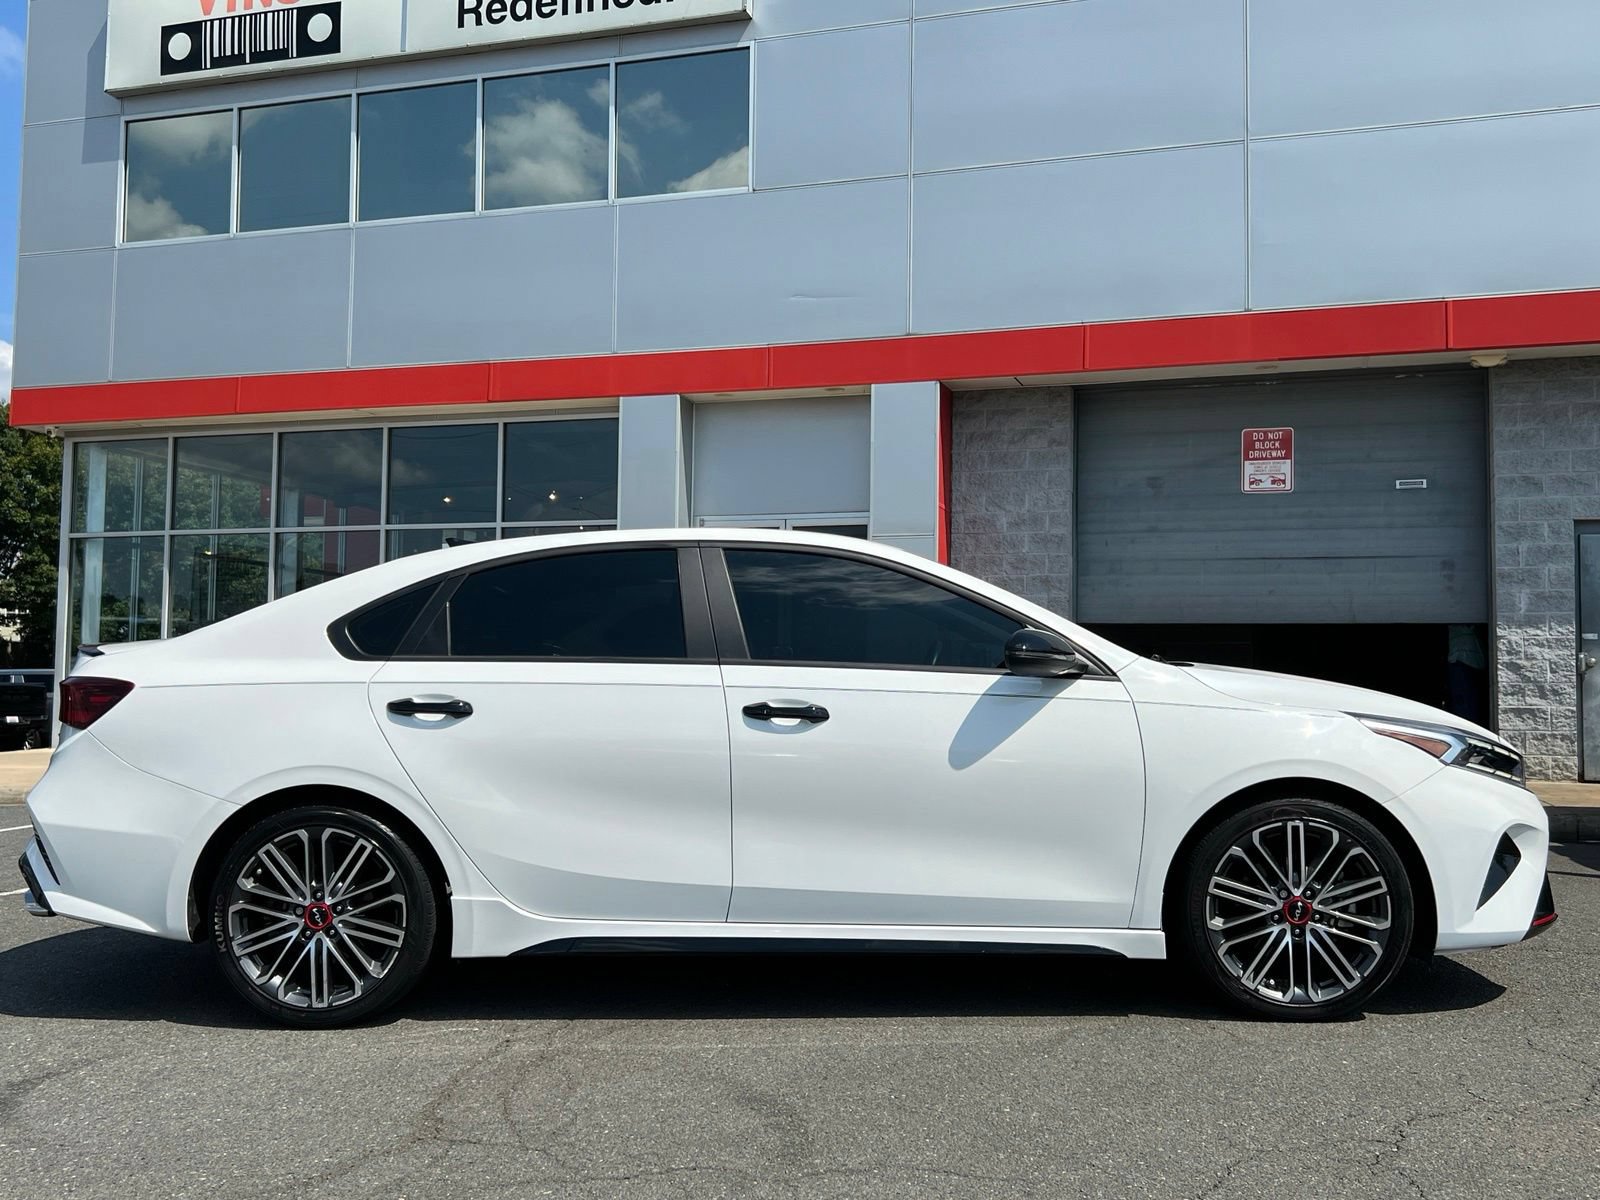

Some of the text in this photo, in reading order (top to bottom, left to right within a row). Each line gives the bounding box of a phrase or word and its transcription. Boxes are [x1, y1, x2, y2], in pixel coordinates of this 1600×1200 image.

[457, 0, 675, 28] Reden
[1252, 431, 1283, 440] DO NOT
[1254, 440, 1280, 449] BLOCK
[1248, 450, 1286, 459] DRIVEWAY
